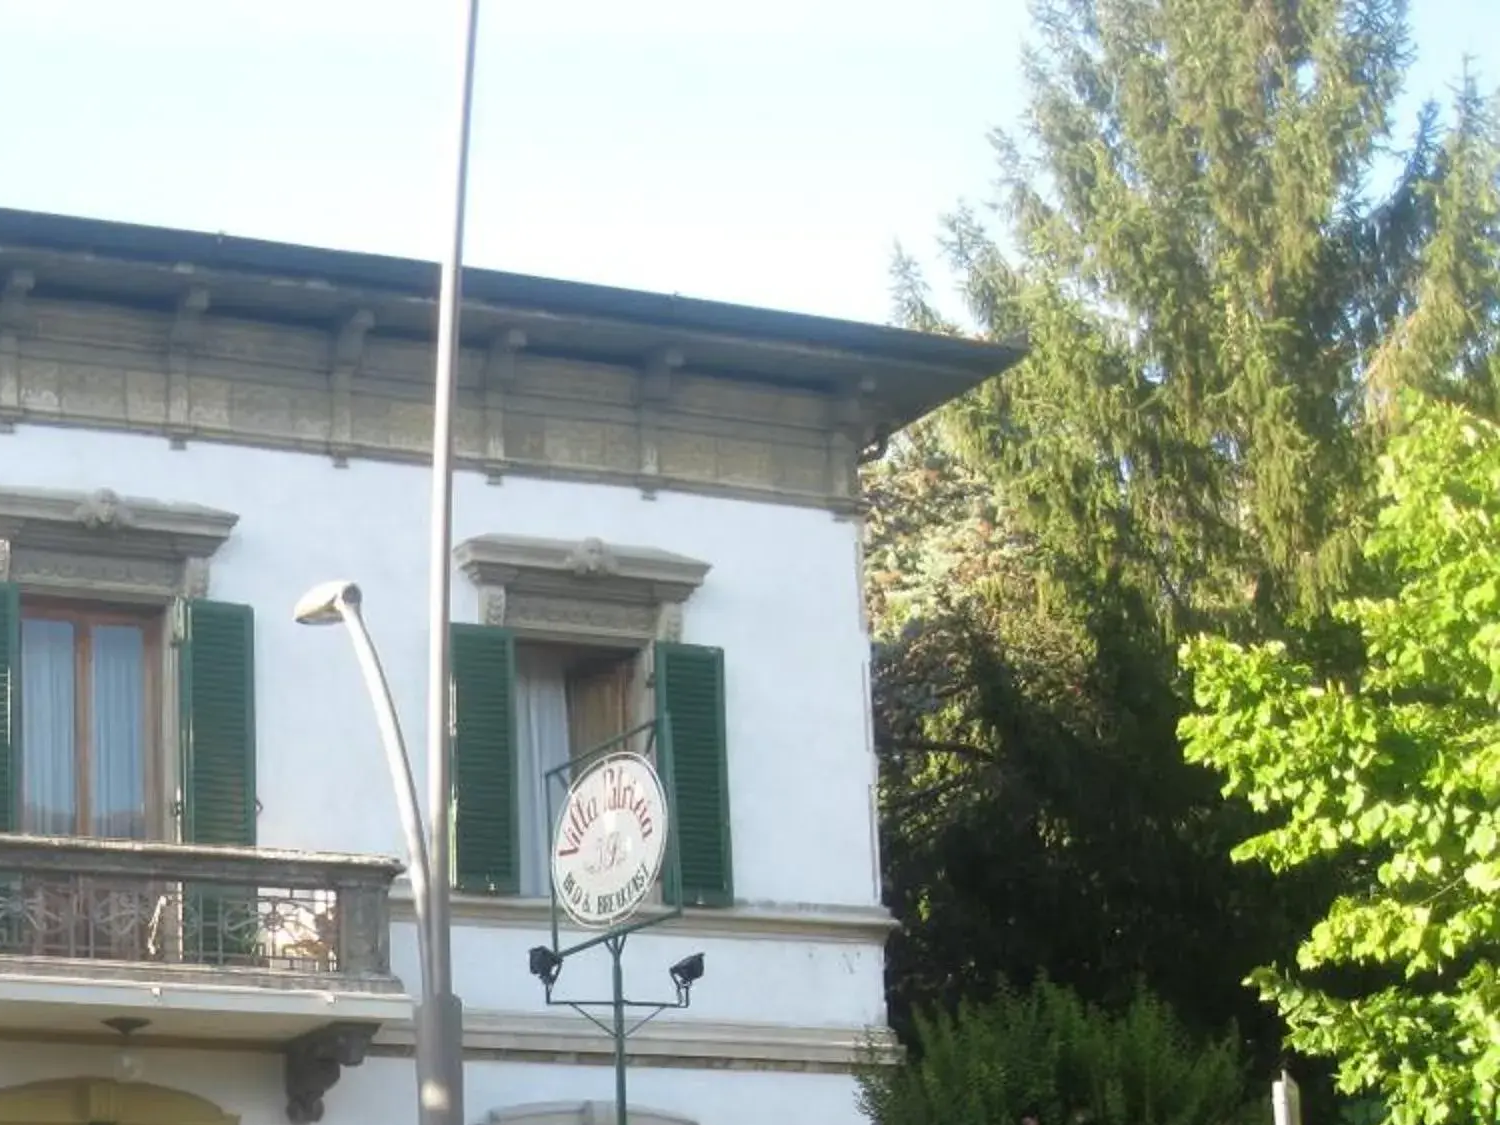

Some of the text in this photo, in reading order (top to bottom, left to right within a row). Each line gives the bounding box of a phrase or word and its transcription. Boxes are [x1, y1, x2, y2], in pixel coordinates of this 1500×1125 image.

[558, 794, 599, 857] Villa
[563, 862, 649, 915] BED & BREAKFAST
